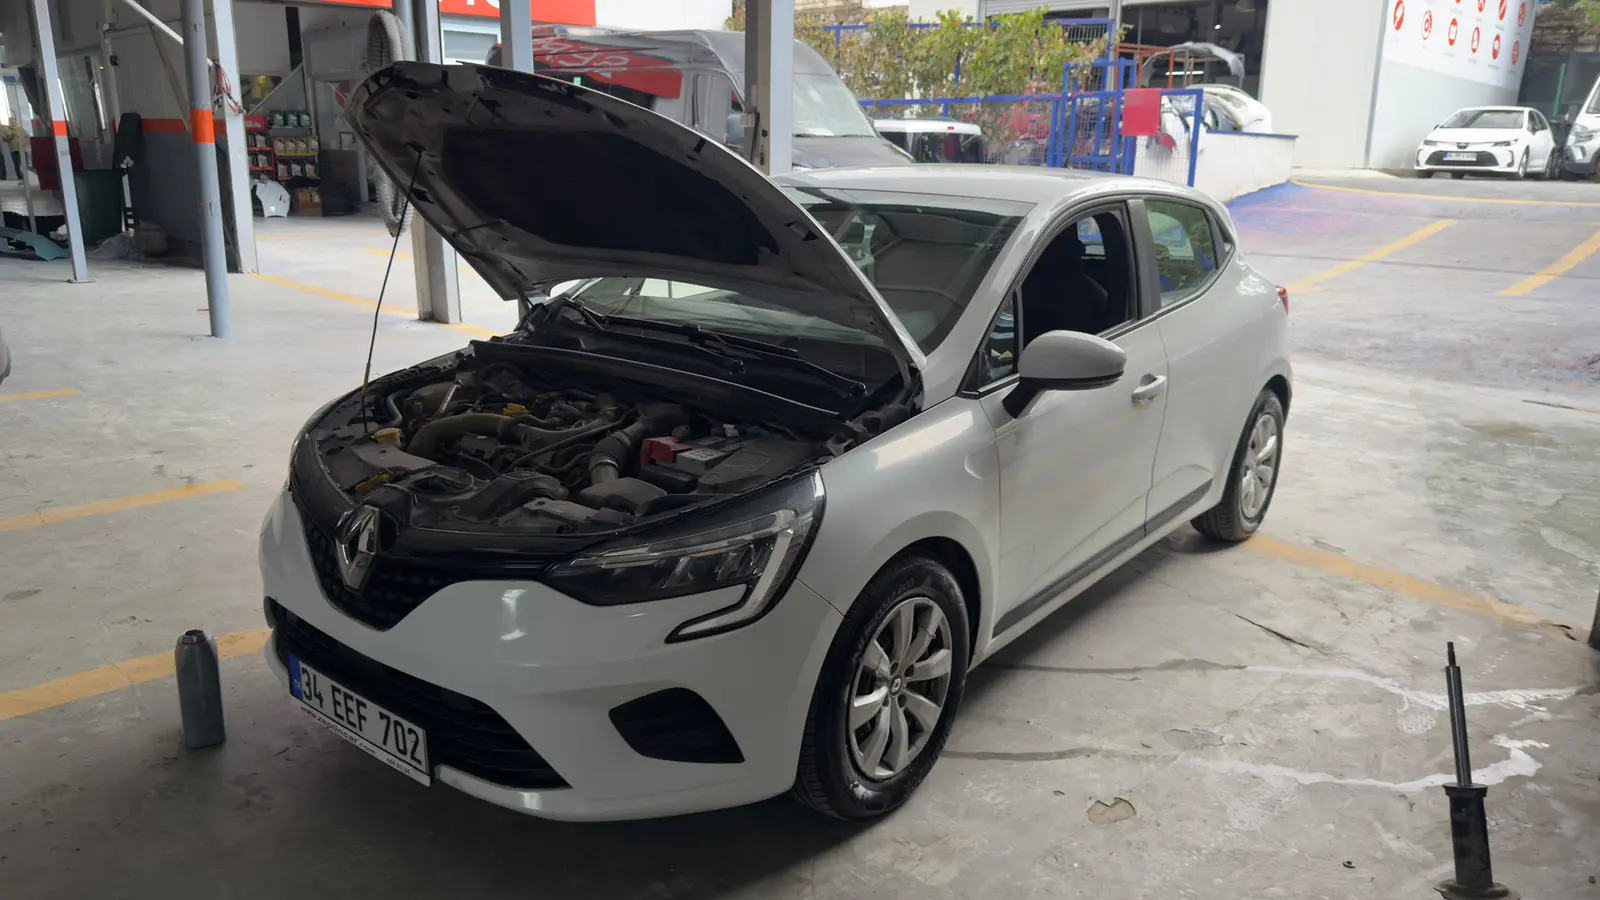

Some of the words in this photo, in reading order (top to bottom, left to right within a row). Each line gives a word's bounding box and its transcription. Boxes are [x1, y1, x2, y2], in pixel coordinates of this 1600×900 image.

[301, 667, 324, 708] 34
[331, 684, 368, 732] EEF
[379, 711, 422, 765] 702
